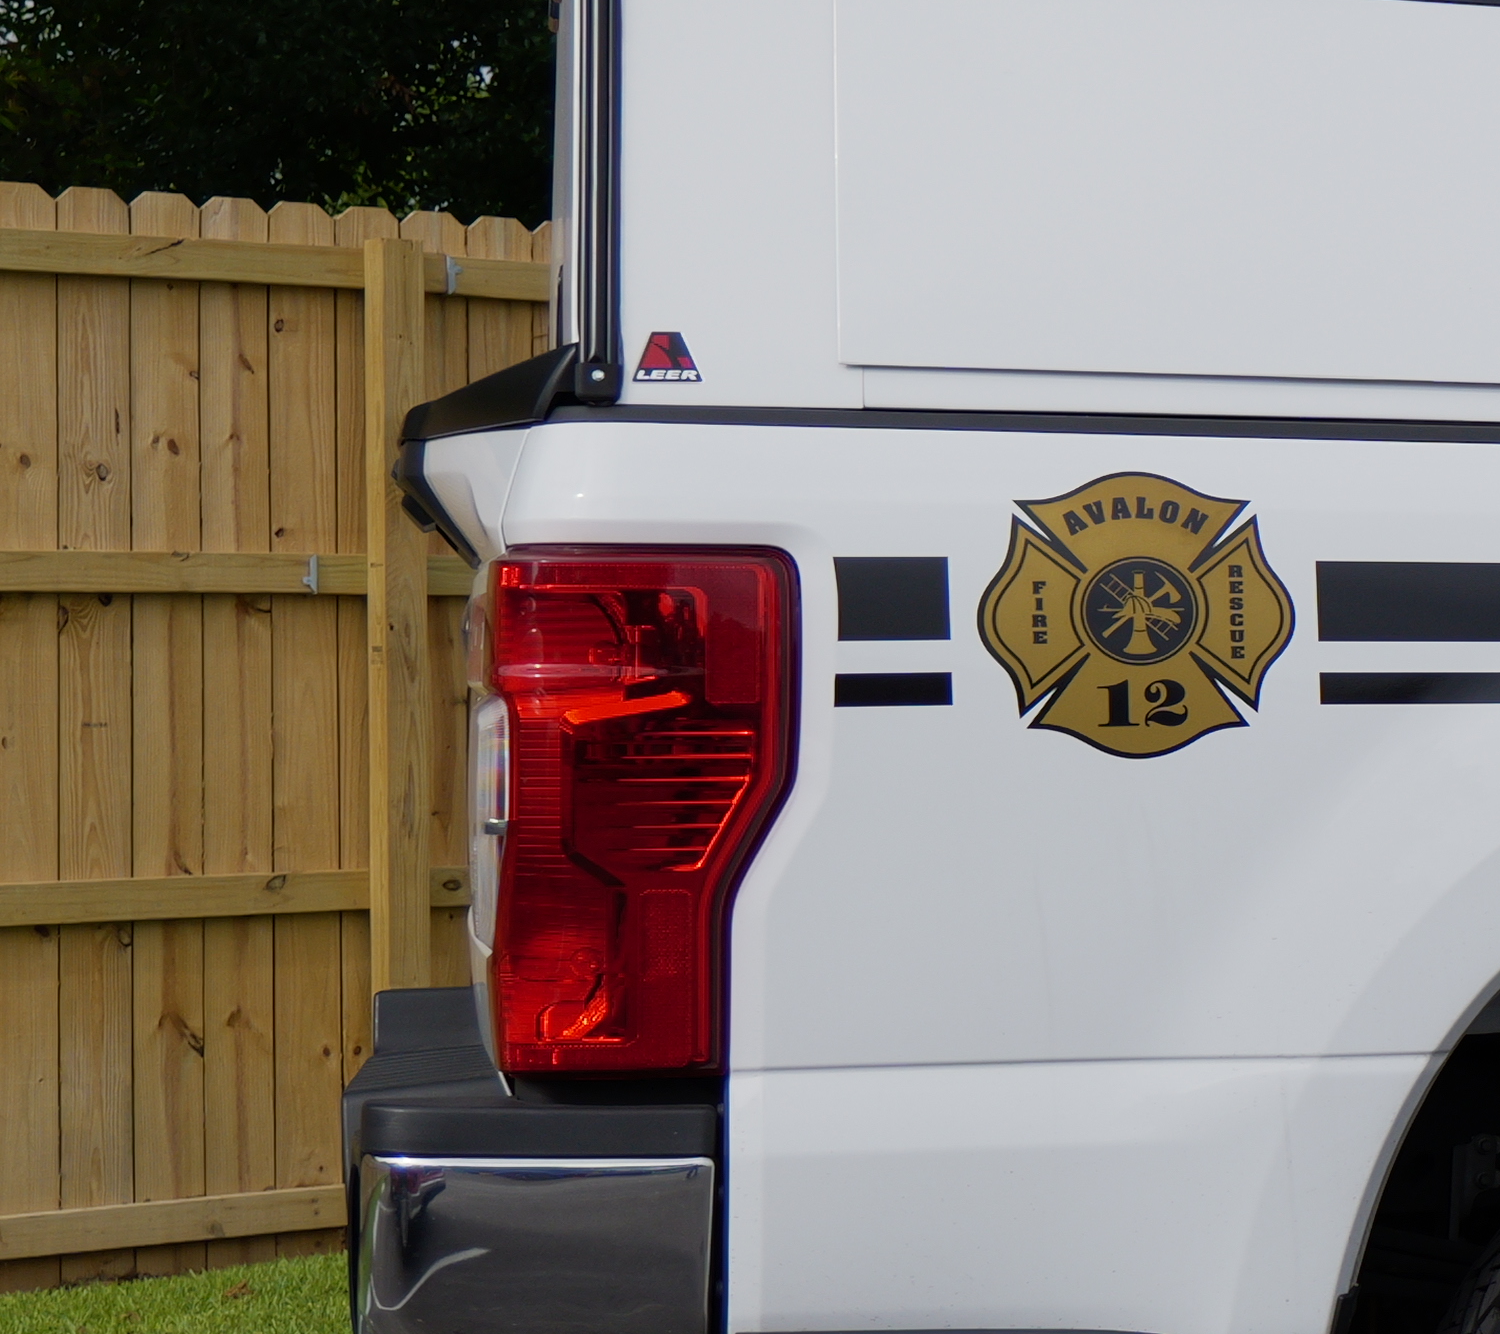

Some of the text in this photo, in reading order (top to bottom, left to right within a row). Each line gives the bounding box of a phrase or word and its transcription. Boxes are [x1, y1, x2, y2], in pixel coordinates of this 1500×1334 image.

[636, 369, 698, 381] LEER
[1061, 496, 1209, 536] AVALON
[1032, 580, 1048, 645] FIRE
[1228, 564, 1246, 660] RESCUE
[1097, 679, 1189, 727] 12
